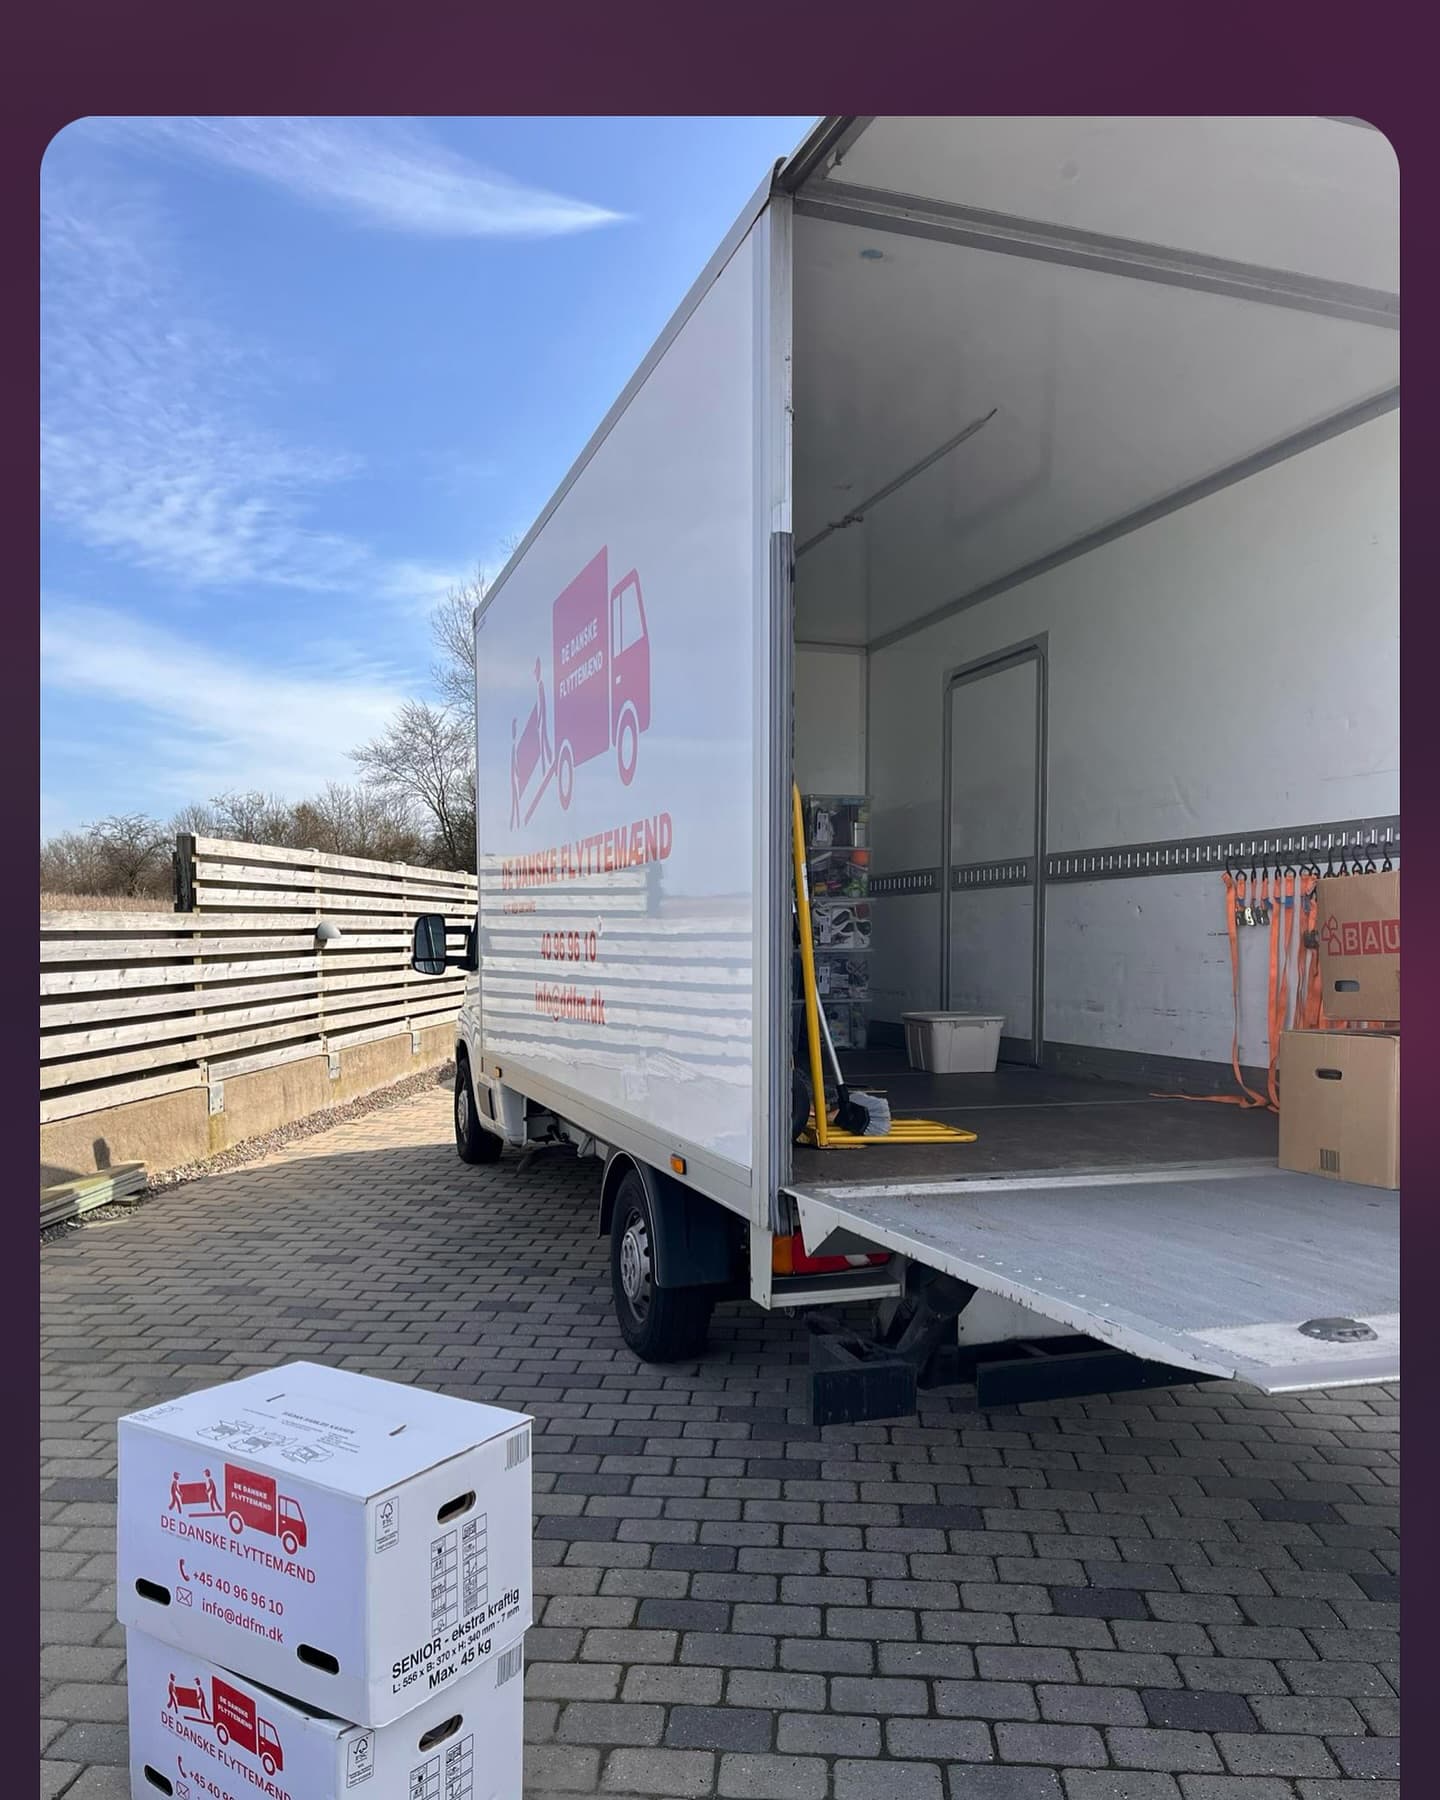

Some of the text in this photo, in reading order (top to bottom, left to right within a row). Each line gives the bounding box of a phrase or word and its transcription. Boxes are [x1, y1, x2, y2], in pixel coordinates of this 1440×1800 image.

[561, 617, 598, 665] DE DANSKE
[560, 650, 603, 698] FLYTTEMÆND
[502, 812, 673, 890] DE DANSKE FLYTTEMÆND
[541, 929, 596, 962] 40 96 96 10
[1344, 925, 1400, 950] BAU
[535, 982, 606, 1025] info@ddfm.dk
[231, 1492, 272, 1511] FLYTTEMÆND
[233, 1482, 267, 1499] DE DANSKE
[161, 1515, 176, 1531] DE
[179, 1521, 227, 1550] DANSKE
[230, 1540, 316, 1584] FLYTTEMÆND
[193, 1571, 284, 1616] +45 40 96 96 10
[202, 1598, 283, 1644] info@ddfm.dk
[392, 1637, 441, 1679] SENIOR
[451, 1612, 485, 1641] ekstra
[487, 1588, 520, 1618] kraftig
[392, 1683, 401, 1694] L:
[402, 1671, 418, 1688] 556
[419, 1669, 425, 1677] x
[426, 1662, 435, 1673] B:
[436, 1651, 450, 1666] 370
[458, 1642, 466, 1652] H:
[467, 1631, 481, 1645] 340
[481, 1621, 495, 1636] mm
[507, 1605, 520, 1618] mm
[429, 1638, 491, 1689] Max. 45 kg
[217, 1703, 253, 1730] FLYTTEMÆND
[219, 1695, 248, 1718] DE DANSKE
[161, 1711, 174, 1729] DE
[176, 1721, 216, 1758] DANSKE
[190, 1771, 205, 1788] +45
[207, 1781, 220, 1799] 40
